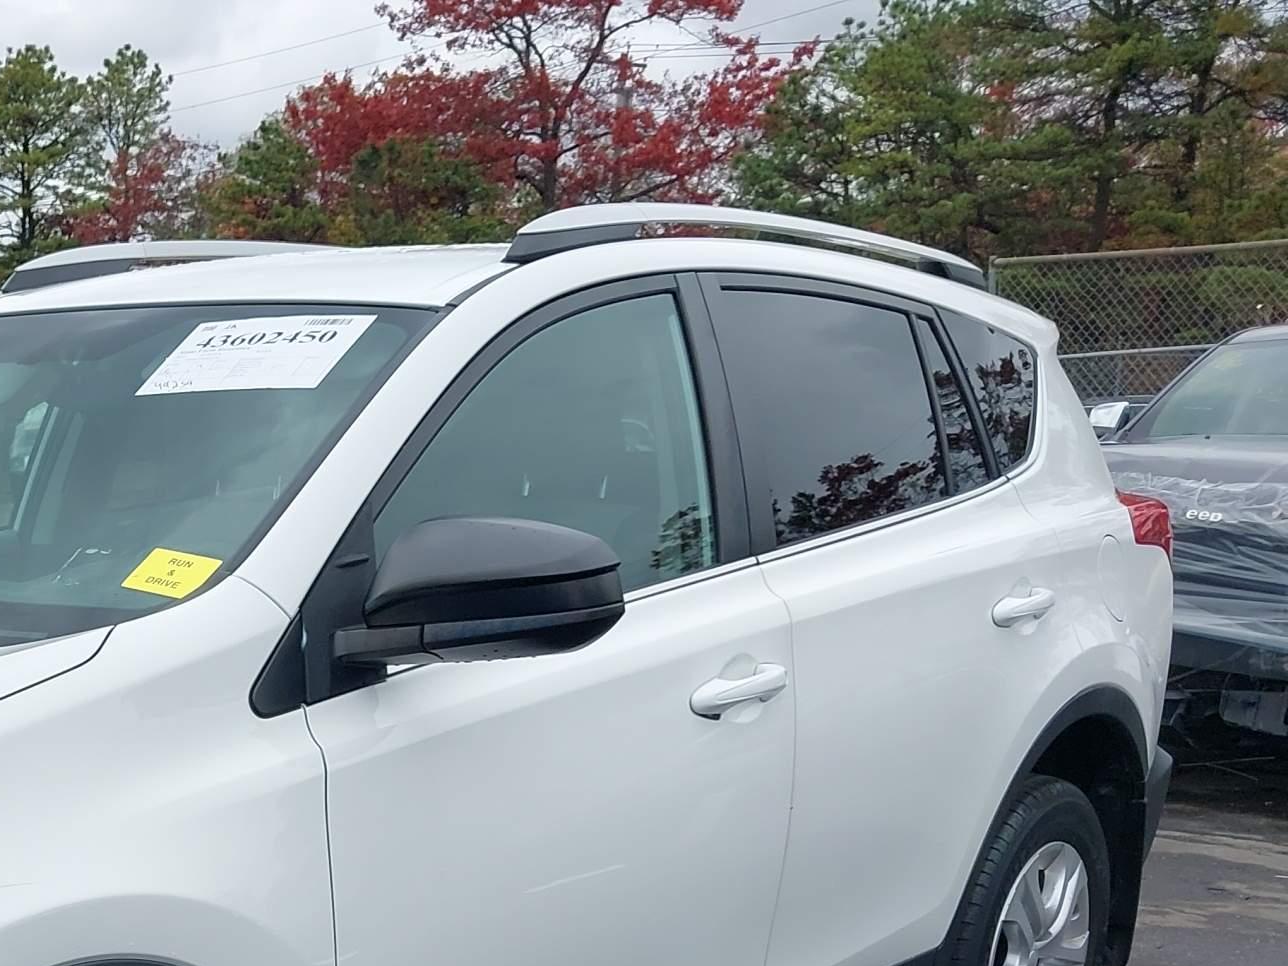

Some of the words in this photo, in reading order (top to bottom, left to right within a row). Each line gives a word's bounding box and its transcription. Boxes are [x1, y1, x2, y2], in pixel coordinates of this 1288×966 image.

[196, 330, 338, 348] 43602450
[168, 557, 194, 568] RUN
[167, 569, 176, 577] &
[145, 575, 181, 589] DRIVE
